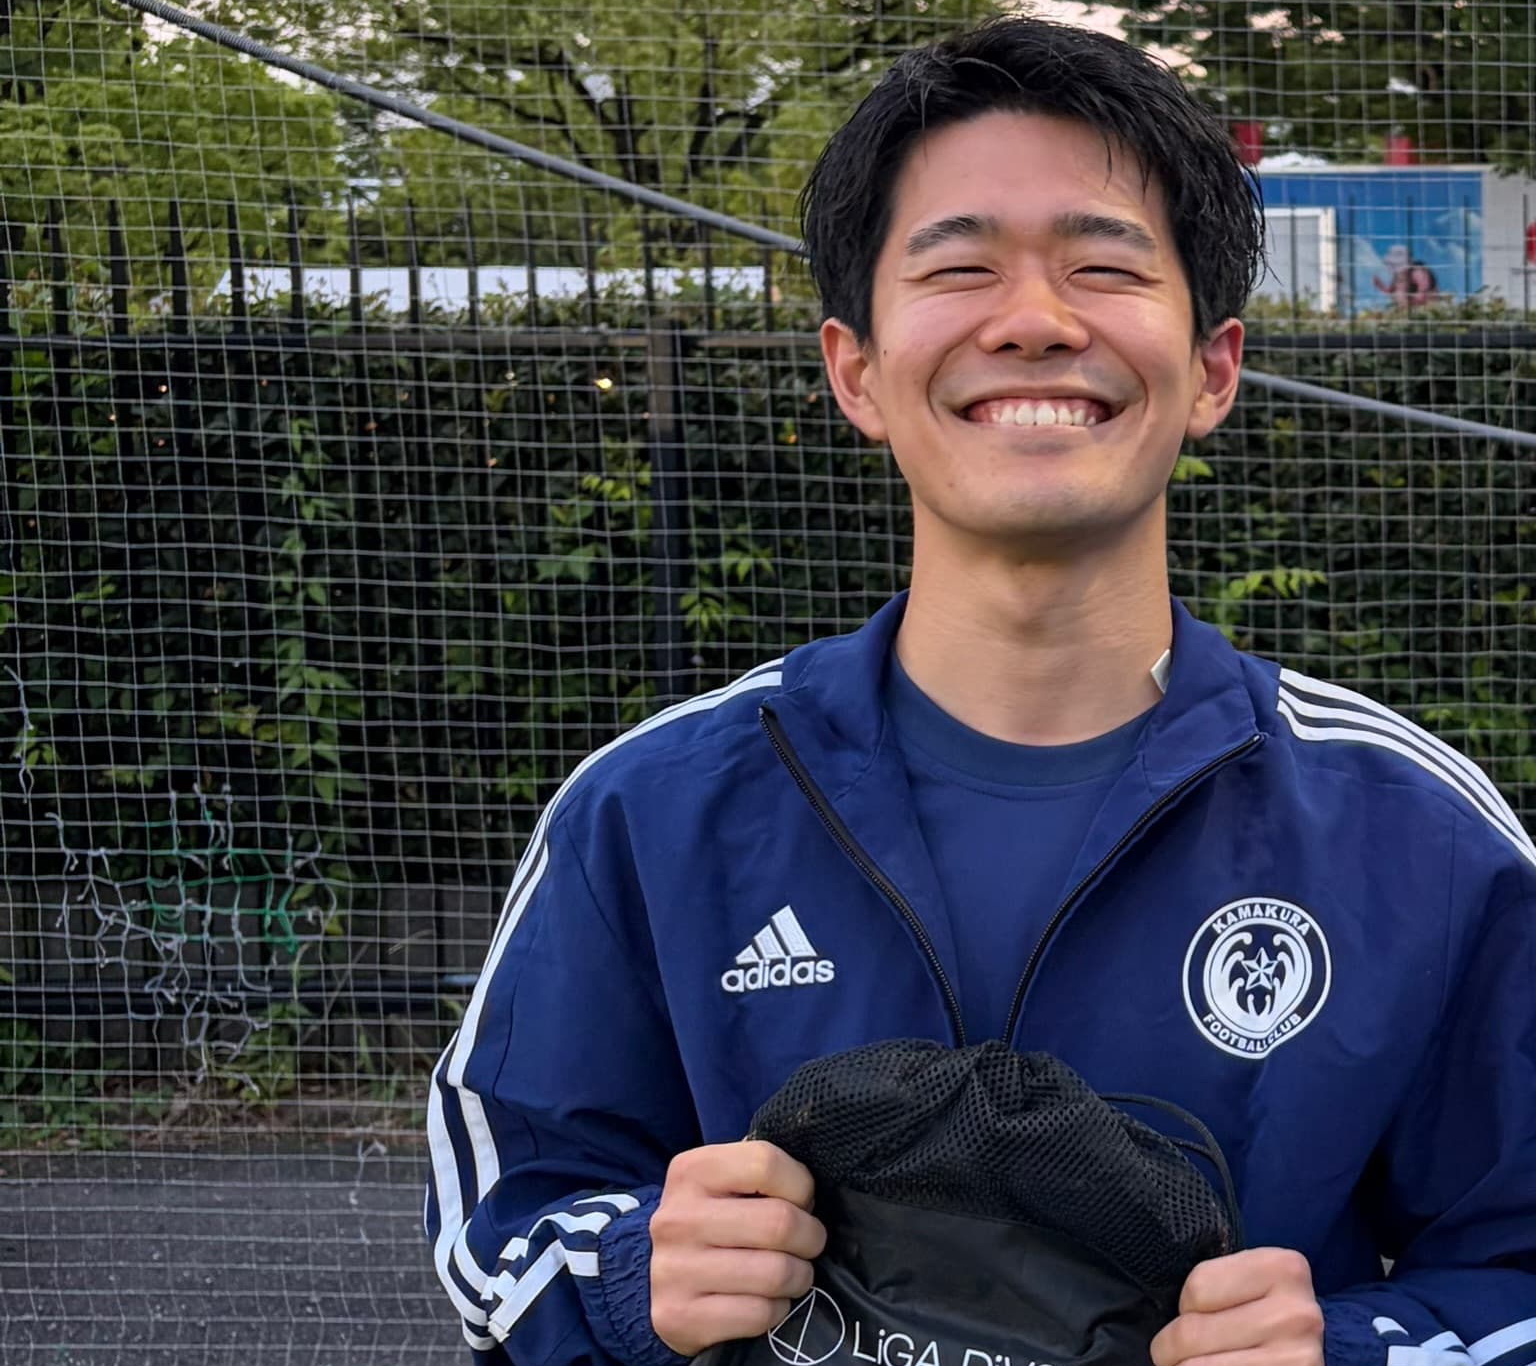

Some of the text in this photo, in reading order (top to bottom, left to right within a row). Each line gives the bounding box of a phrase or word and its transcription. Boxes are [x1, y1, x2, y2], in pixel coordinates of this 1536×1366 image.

[1212, 904, 1311, 935] KAMAKURA
[721, 955, 836, 993] adidas
[1267, 1012, 1302, 1045] CLUB
